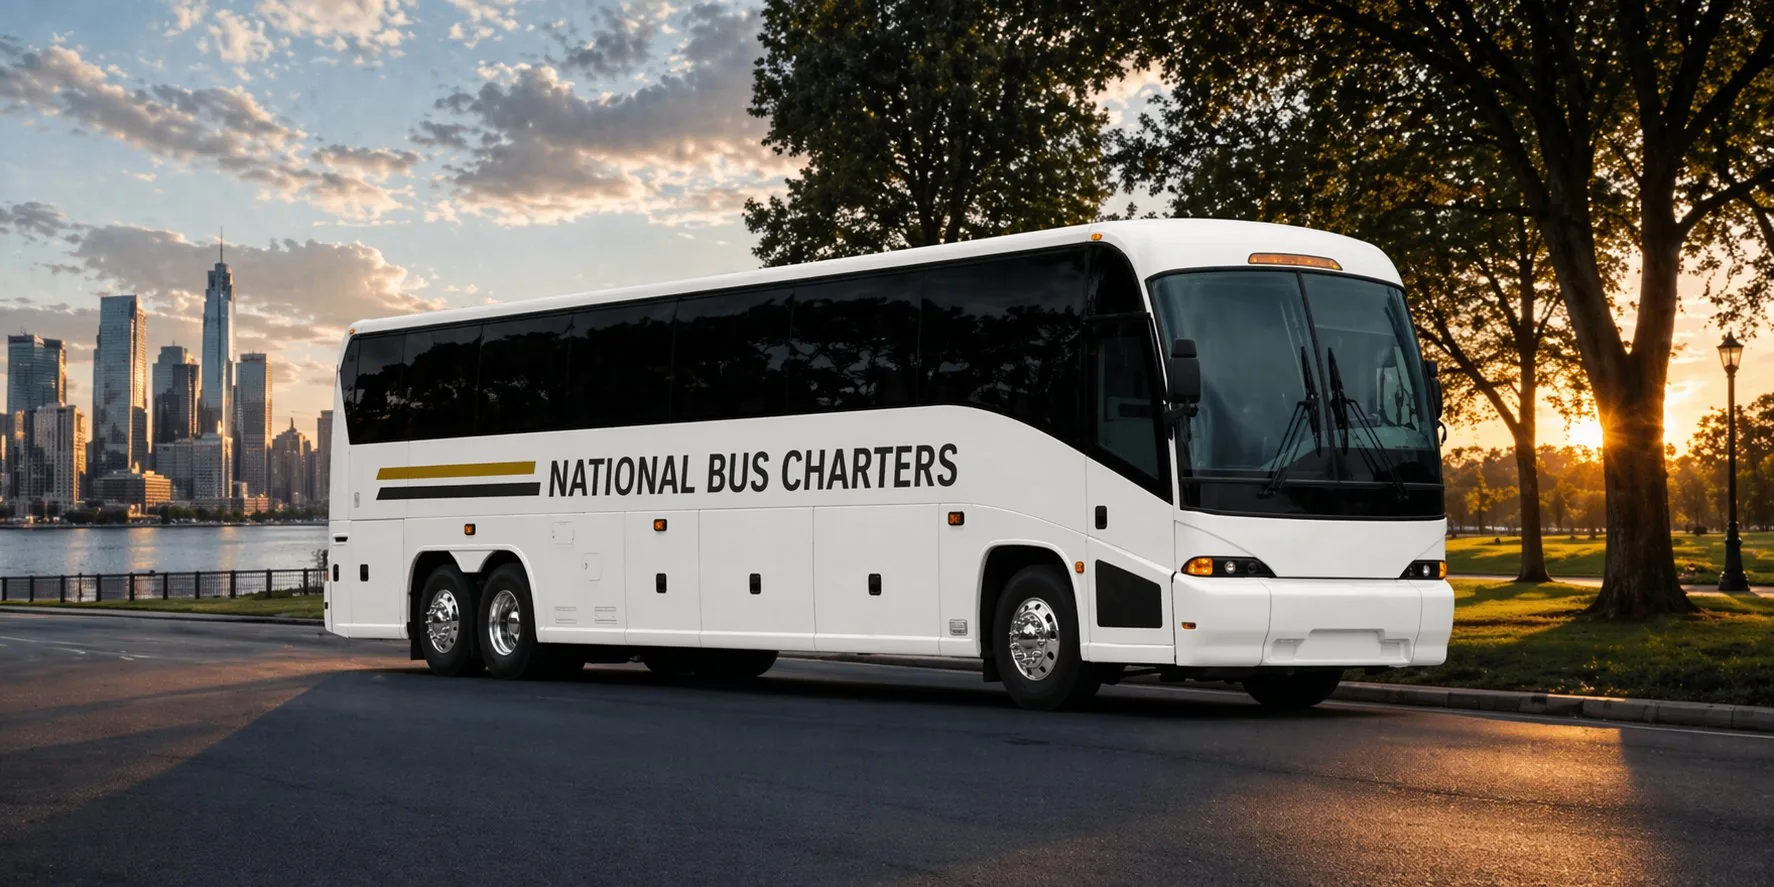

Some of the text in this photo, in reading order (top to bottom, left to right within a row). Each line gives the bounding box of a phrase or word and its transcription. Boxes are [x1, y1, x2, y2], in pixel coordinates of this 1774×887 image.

[549, 443, 958, 498] NATIONAL BUS CHARTERS
